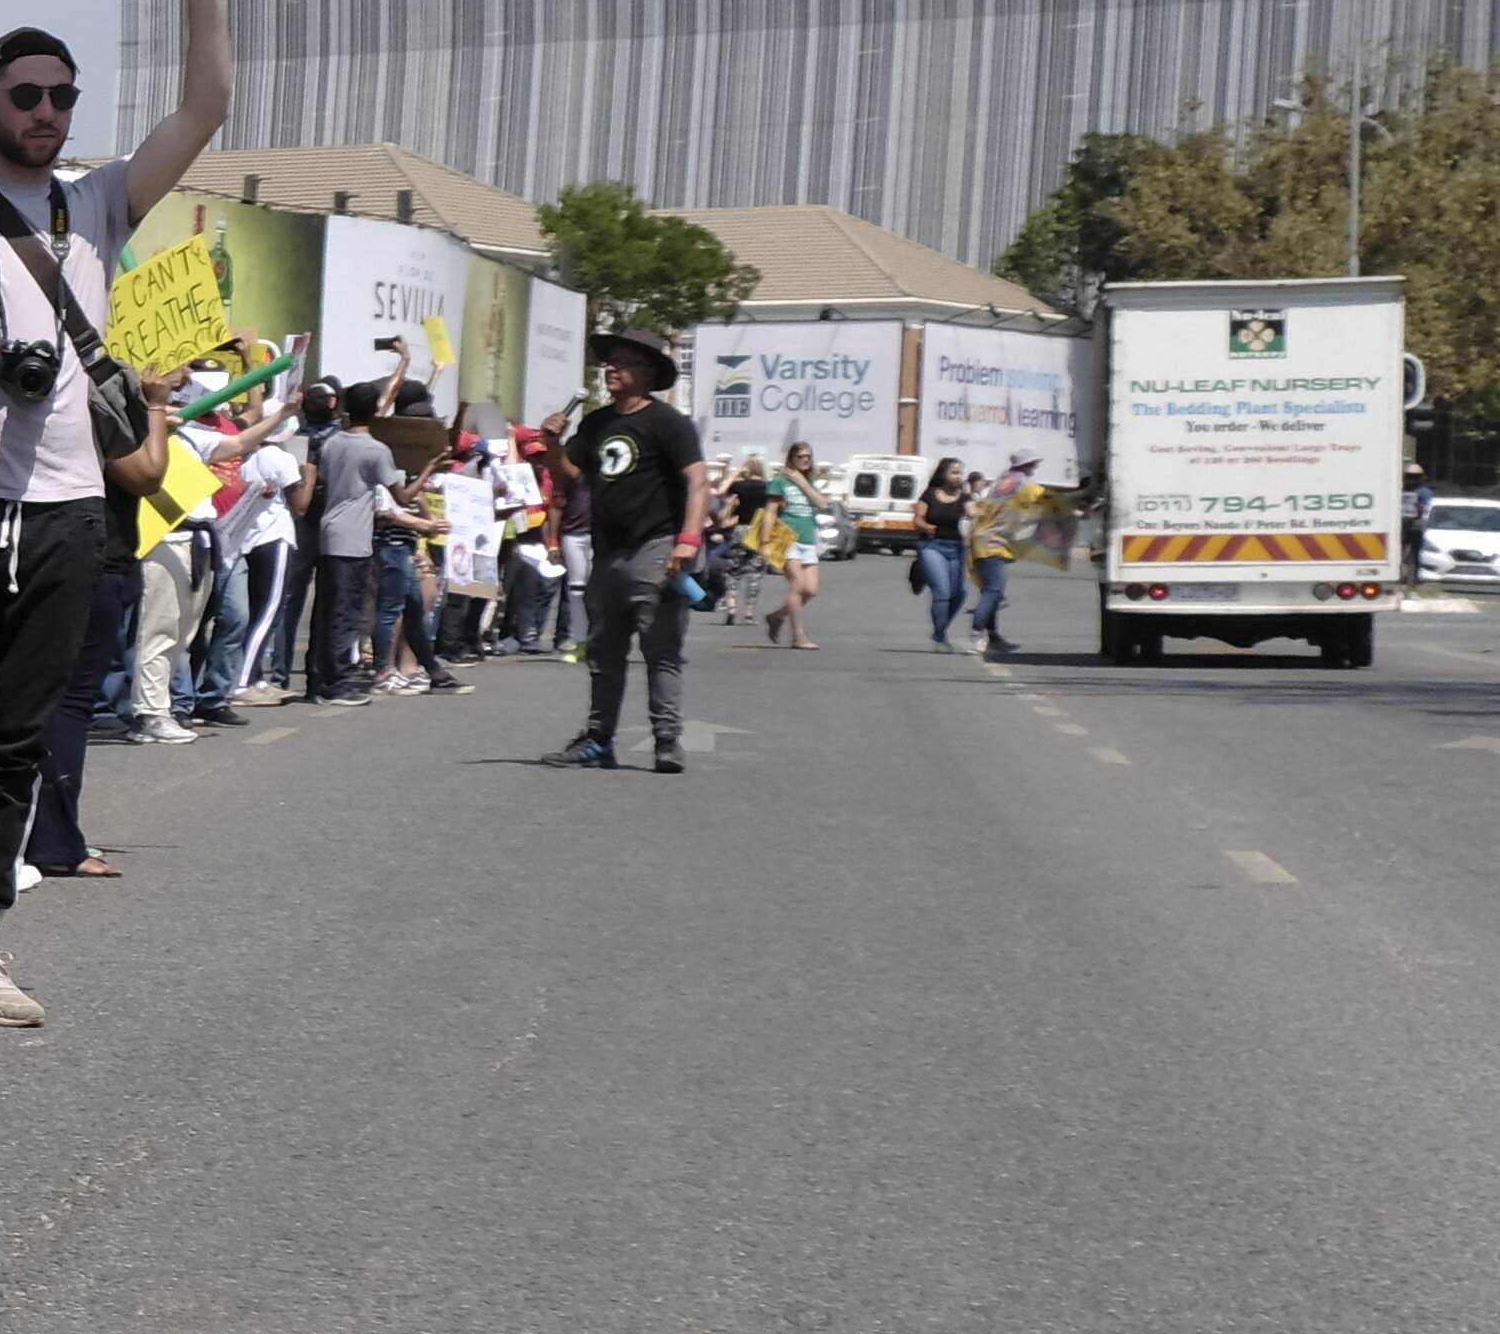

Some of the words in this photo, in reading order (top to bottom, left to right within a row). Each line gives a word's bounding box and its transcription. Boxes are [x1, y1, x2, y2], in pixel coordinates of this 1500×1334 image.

[131, 244, 190, 308] CAN'T
[760, 353, 871, 385] Varsity
[939, 355, 1003, 387] Problem
[1130, 378, 1247, 393] NU-LEAF
[1250, 376, 1382, 392] NURSERY
[760, 384, 875, 418] College
[1133, 403, 1162, 416] The
[1167, 401, 1231, 418] Bedding
[1236, 401, 1278, 415] Plant
[1283, 400, 1367, 417] Specialists
[1213, 420, 1249, 432] order
[1281, 419, 1326, 432] deliver
[1199, 493, 1375, 513] 794-1350
